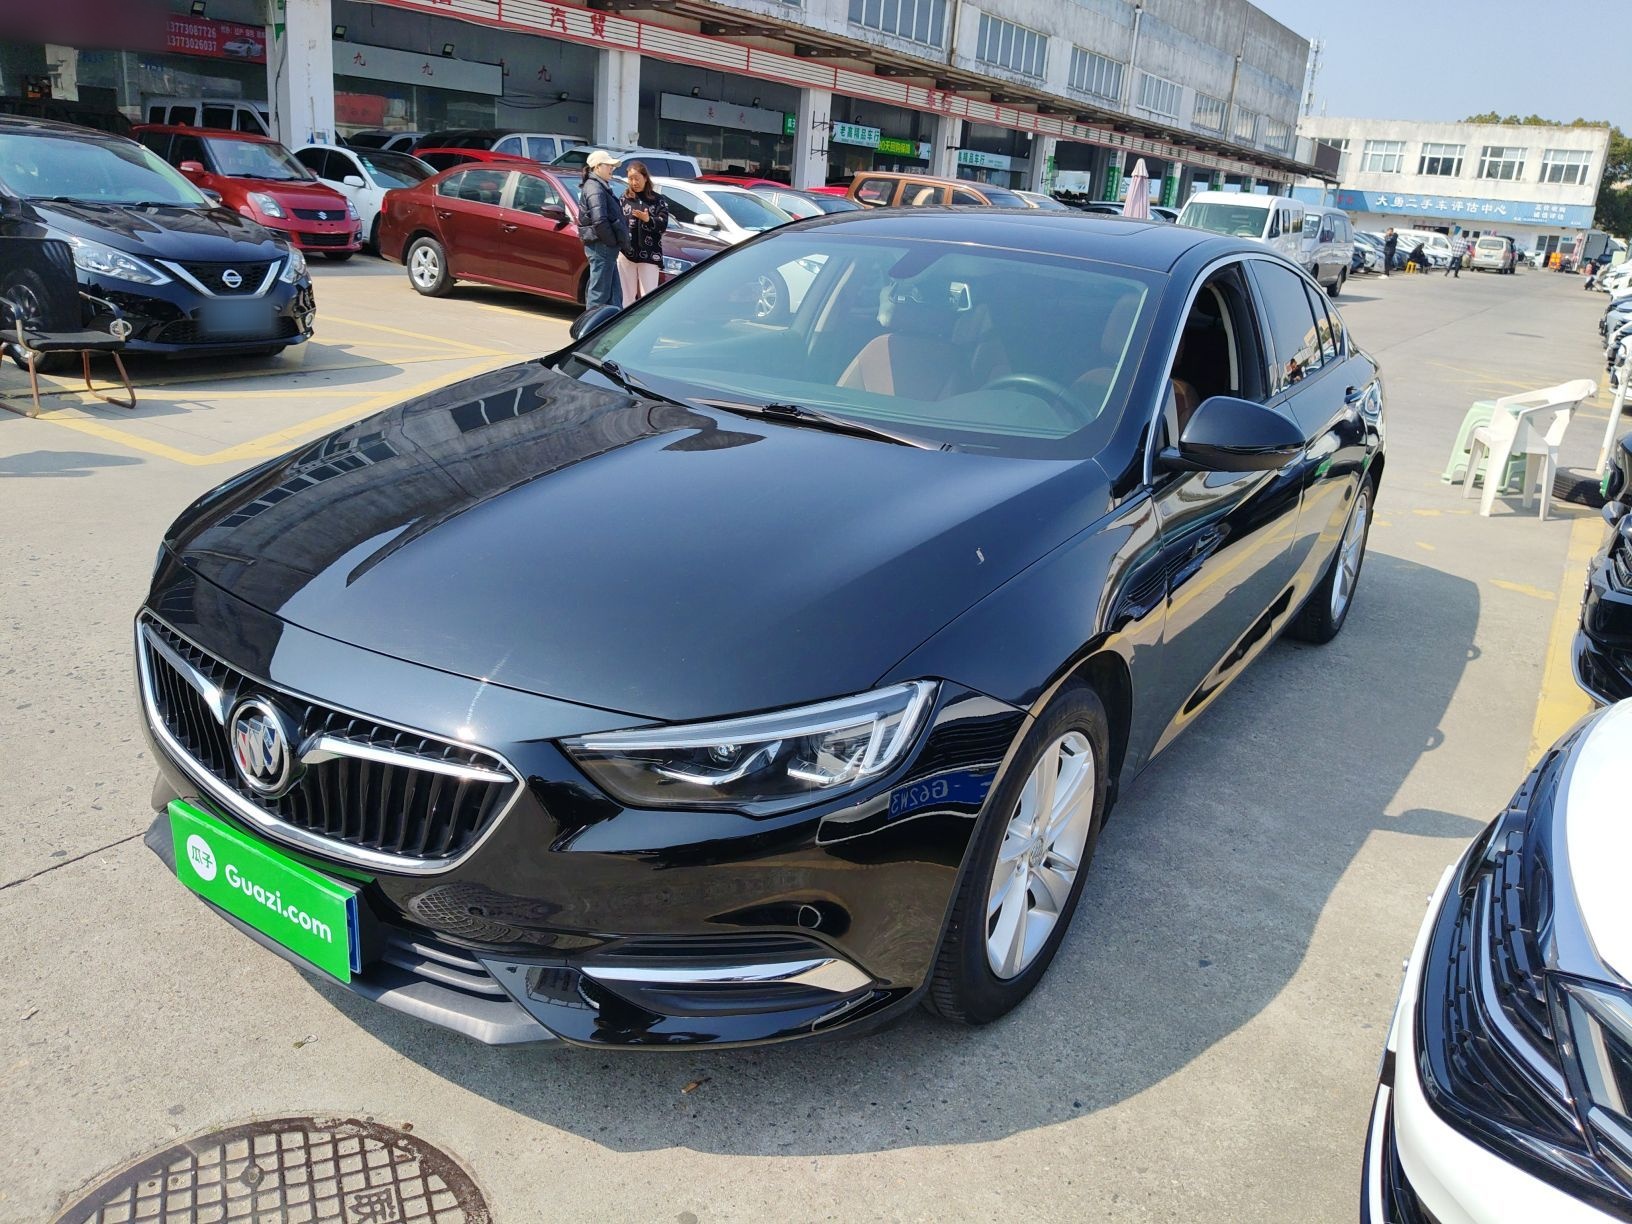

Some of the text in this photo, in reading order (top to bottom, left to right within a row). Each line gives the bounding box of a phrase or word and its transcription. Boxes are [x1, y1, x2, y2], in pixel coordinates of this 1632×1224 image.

[551, 7, 606, 40] 汽贸
[191, 845, 213, 869] 瓜子
[225, 864, 332, 944] Guazi.com
